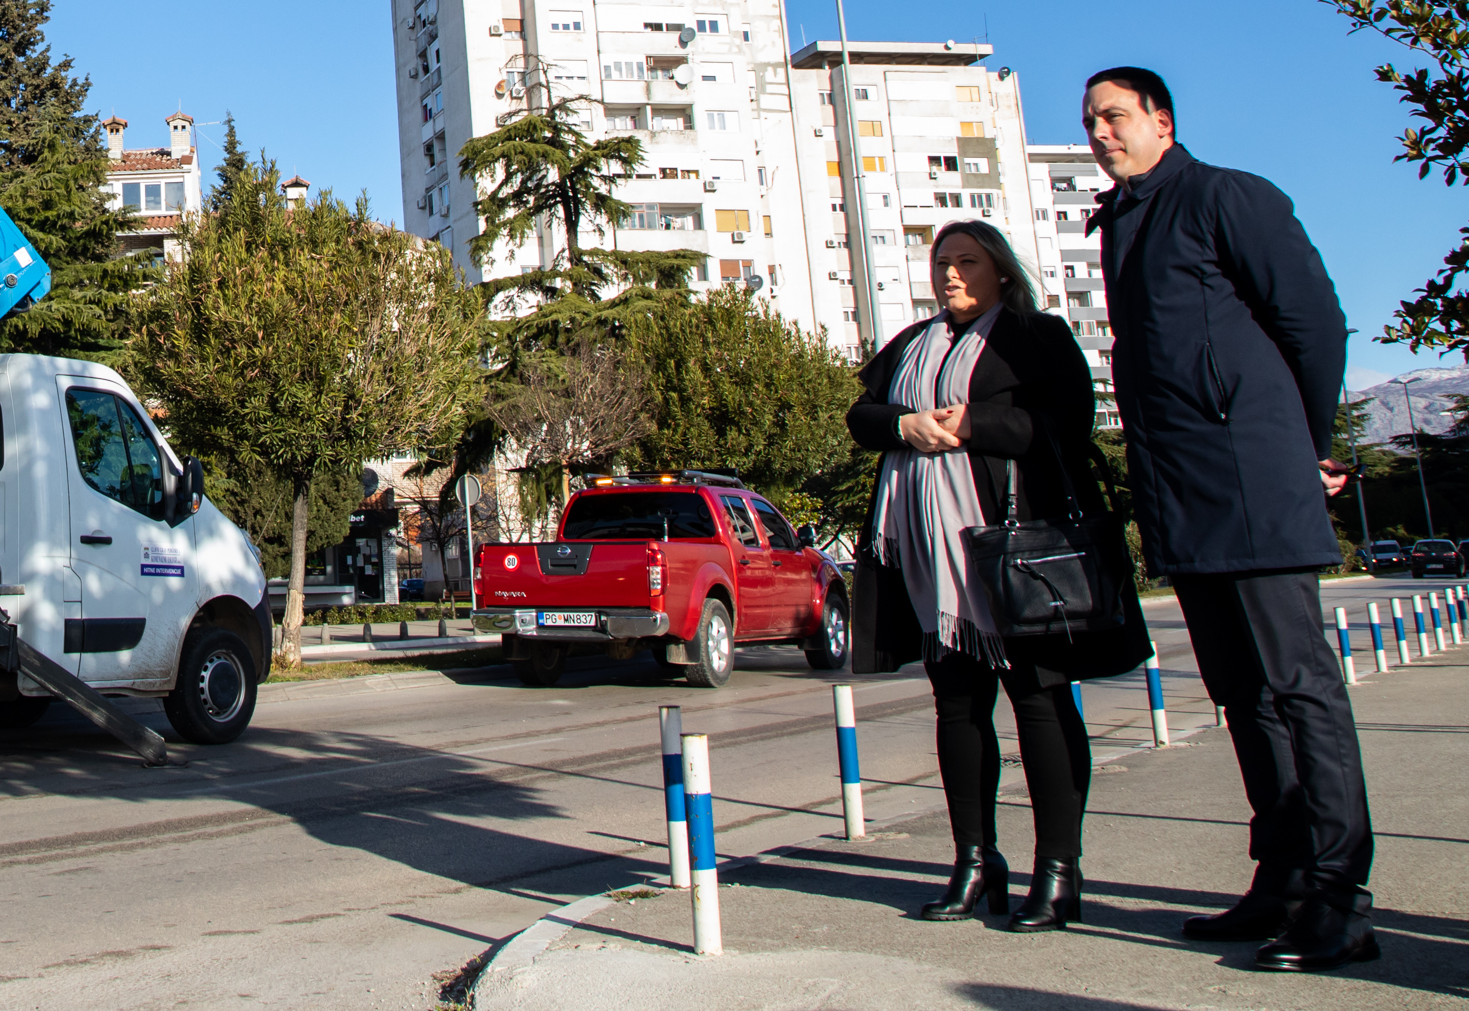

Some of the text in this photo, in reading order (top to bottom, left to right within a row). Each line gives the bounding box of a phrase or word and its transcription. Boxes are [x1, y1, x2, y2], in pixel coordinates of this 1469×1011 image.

[506, 557, 516, 567] 80
[544, 613, 593, 624] PG MN837
